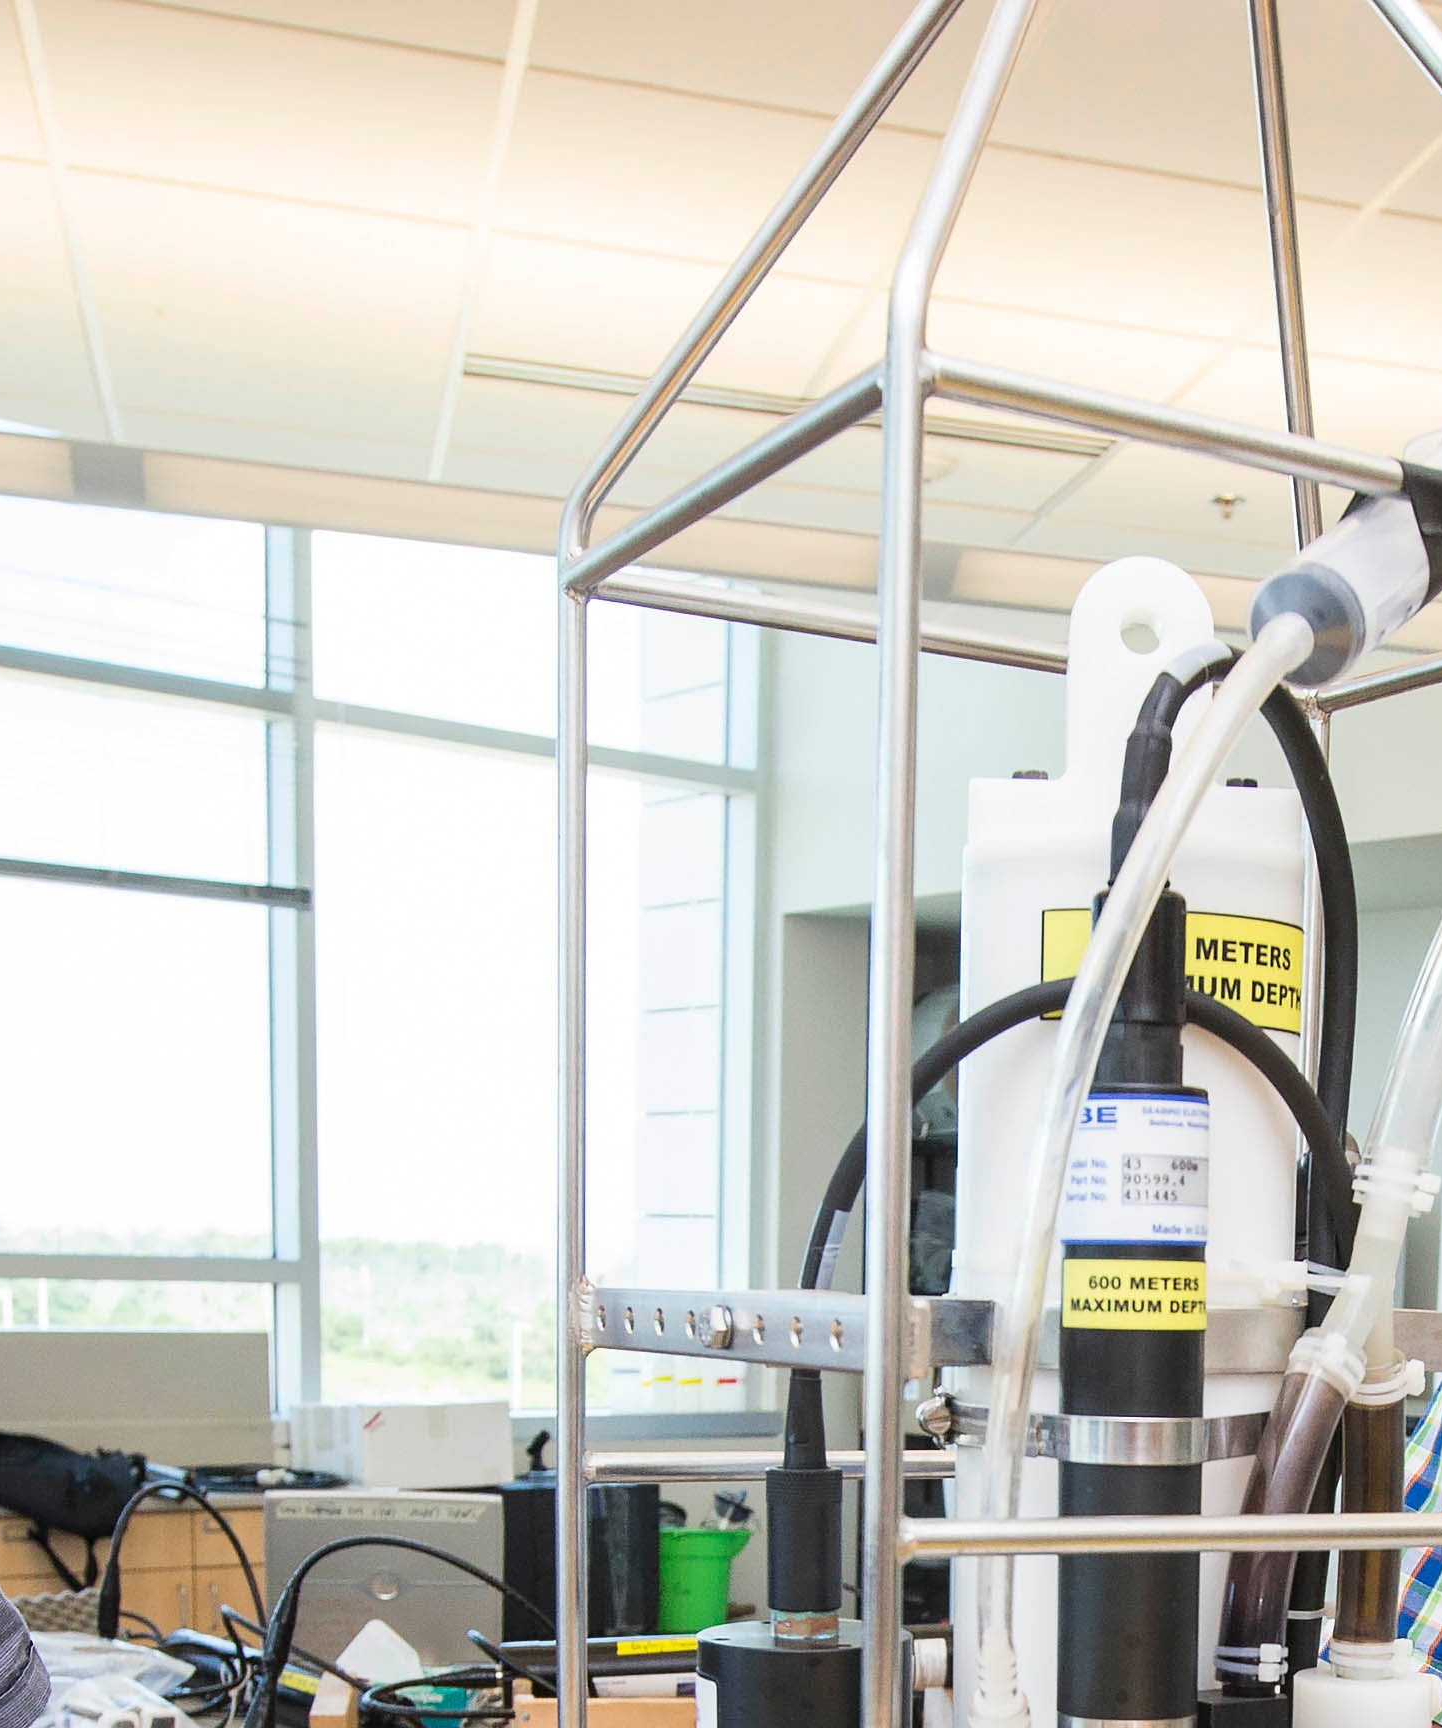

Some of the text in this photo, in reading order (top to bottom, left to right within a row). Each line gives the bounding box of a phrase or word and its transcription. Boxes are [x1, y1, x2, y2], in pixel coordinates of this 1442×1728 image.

[1195, 937, 1291, 971] METERS
[1089, 1276, 1199, 1292] 600 METERS
[1071, 1298, 1162, 1313] MAXIMUM
